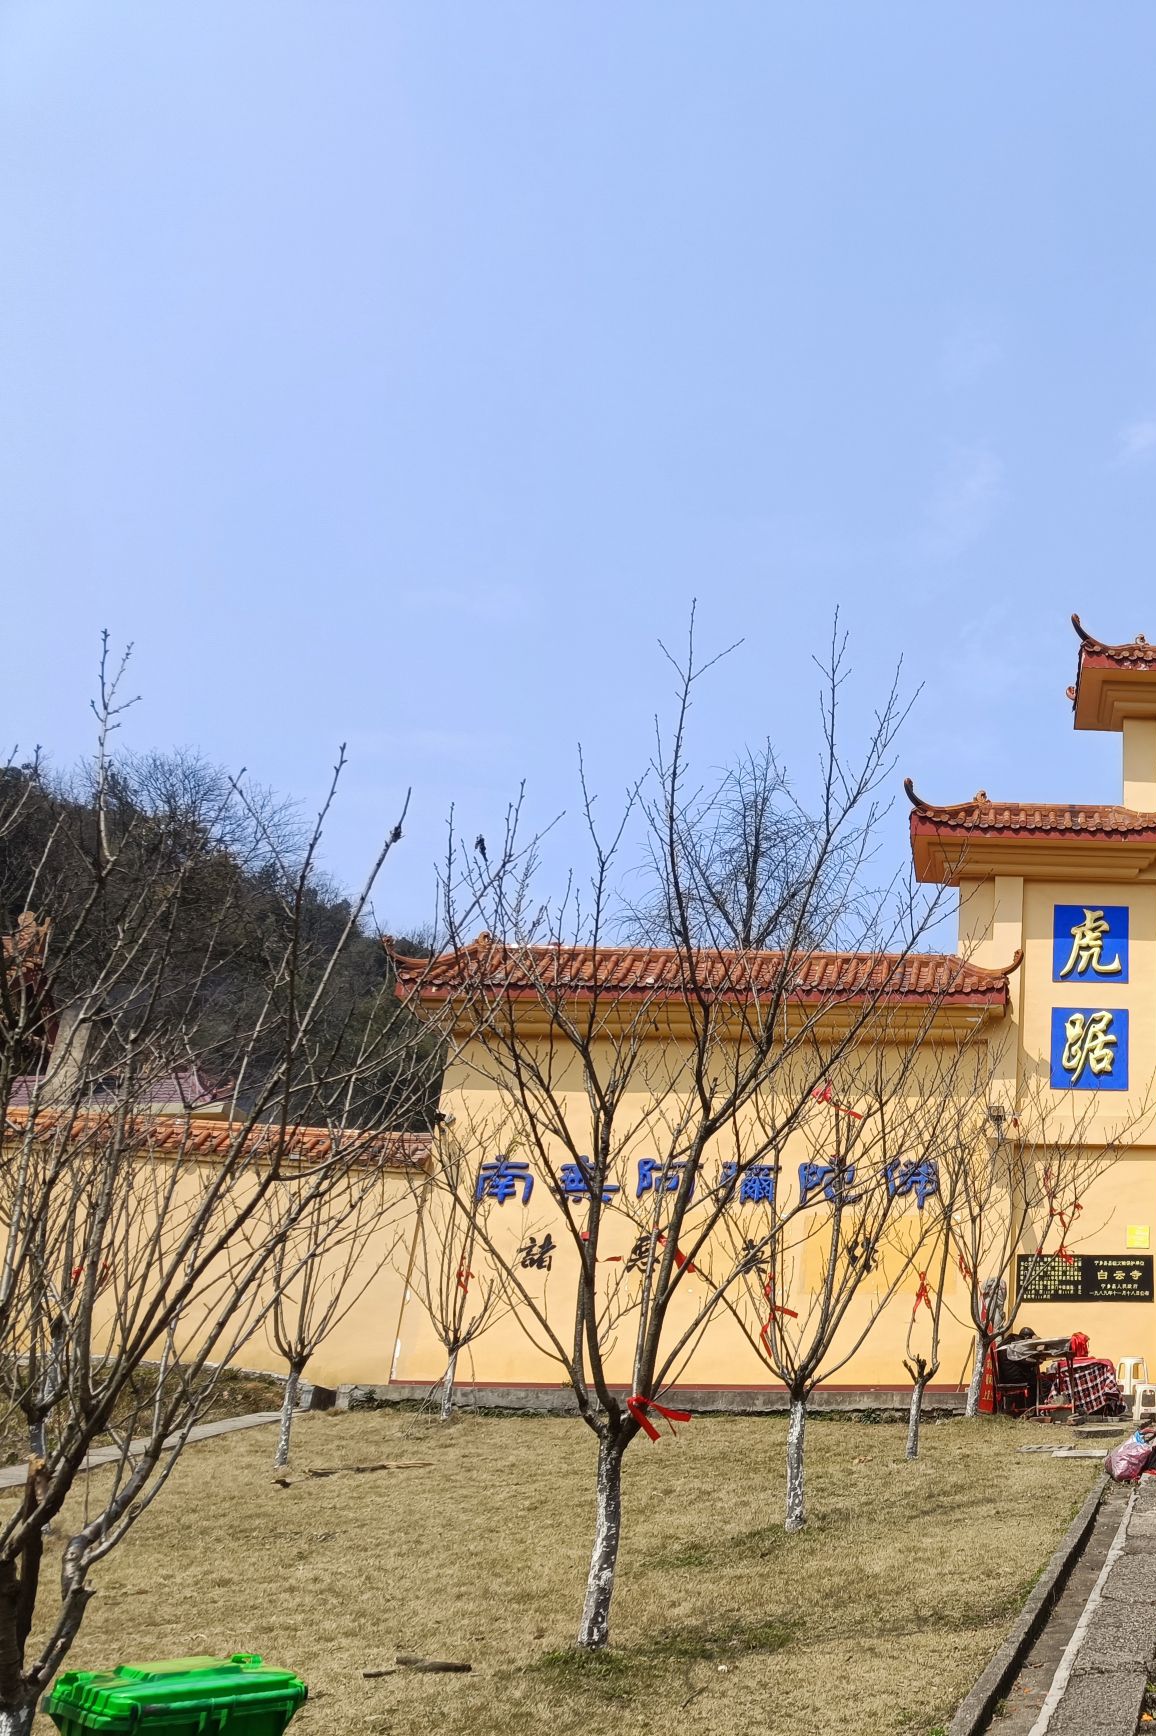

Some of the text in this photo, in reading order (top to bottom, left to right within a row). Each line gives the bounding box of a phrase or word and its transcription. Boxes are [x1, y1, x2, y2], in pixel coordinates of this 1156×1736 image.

[1059, 908, 1122, 1084] 虎踞
[1097, 1269, 1143, 1281] 白云寺
